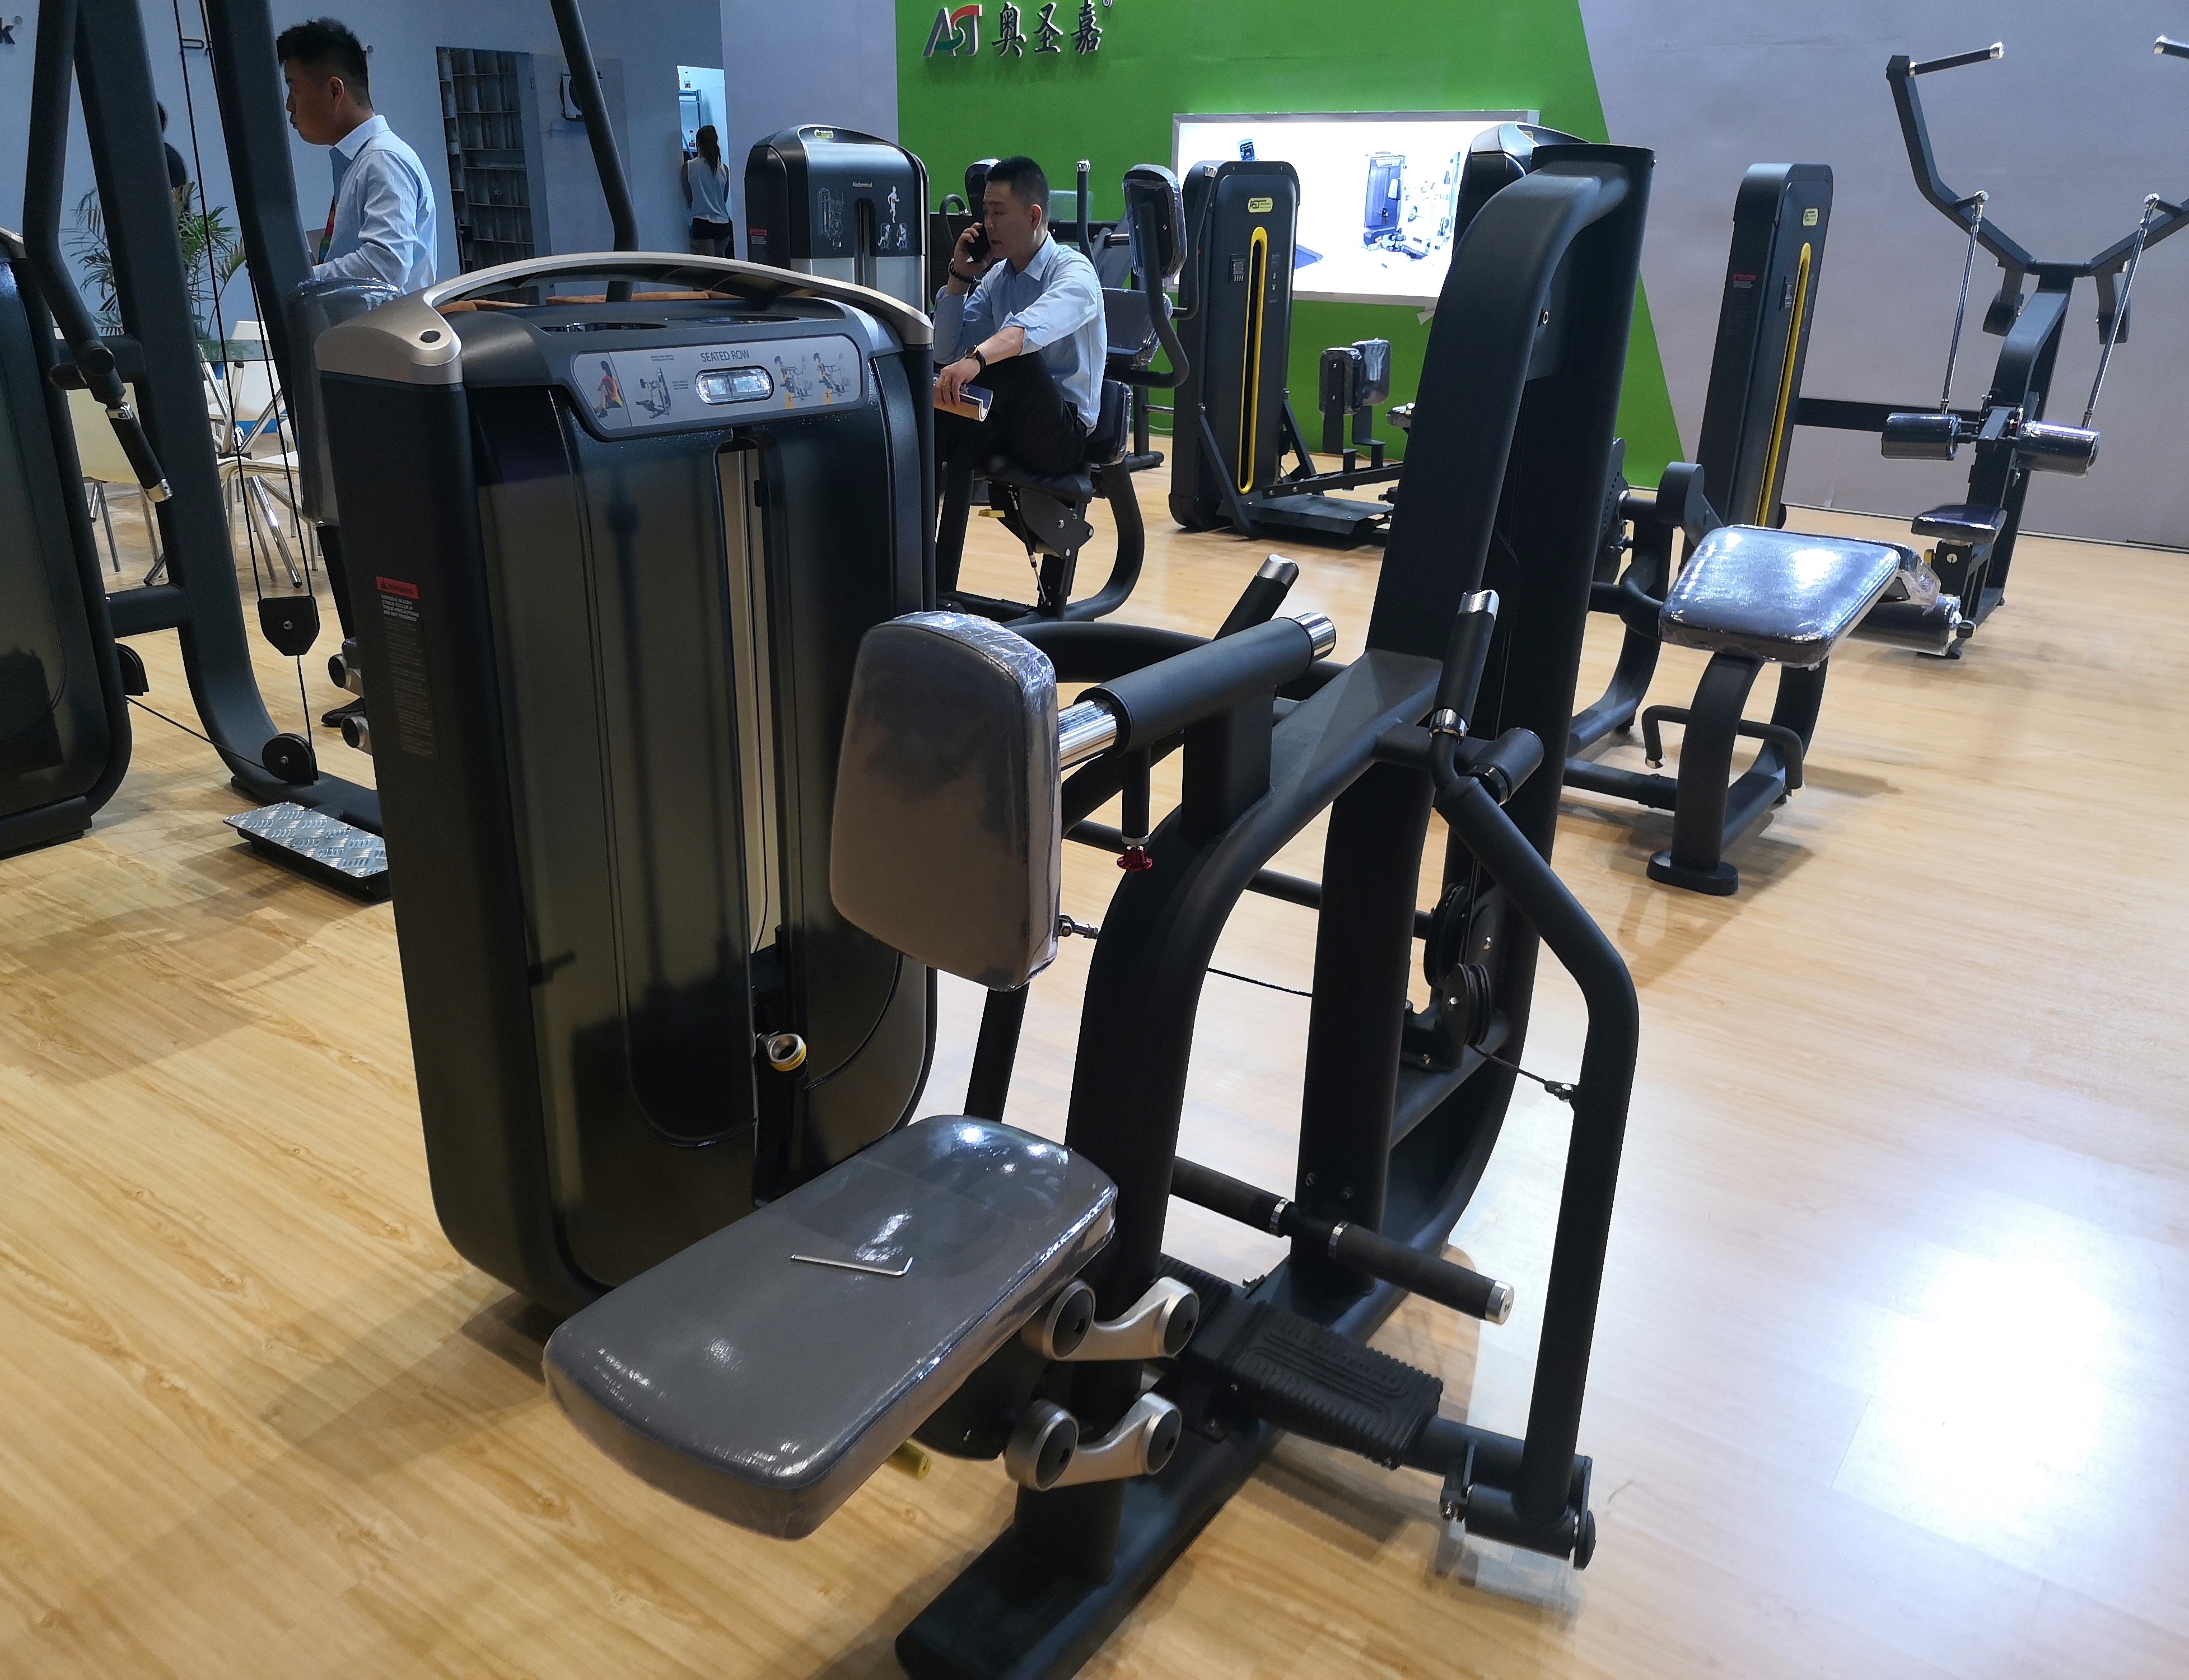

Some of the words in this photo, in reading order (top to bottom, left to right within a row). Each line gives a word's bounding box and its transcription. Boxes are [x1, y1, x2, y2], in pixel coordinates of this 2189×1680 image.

[991, 0, 1103, 58] 奥圣嘉
[700, 351, 730, 362] SEATED
[730, 349, 750, 360] ROW
